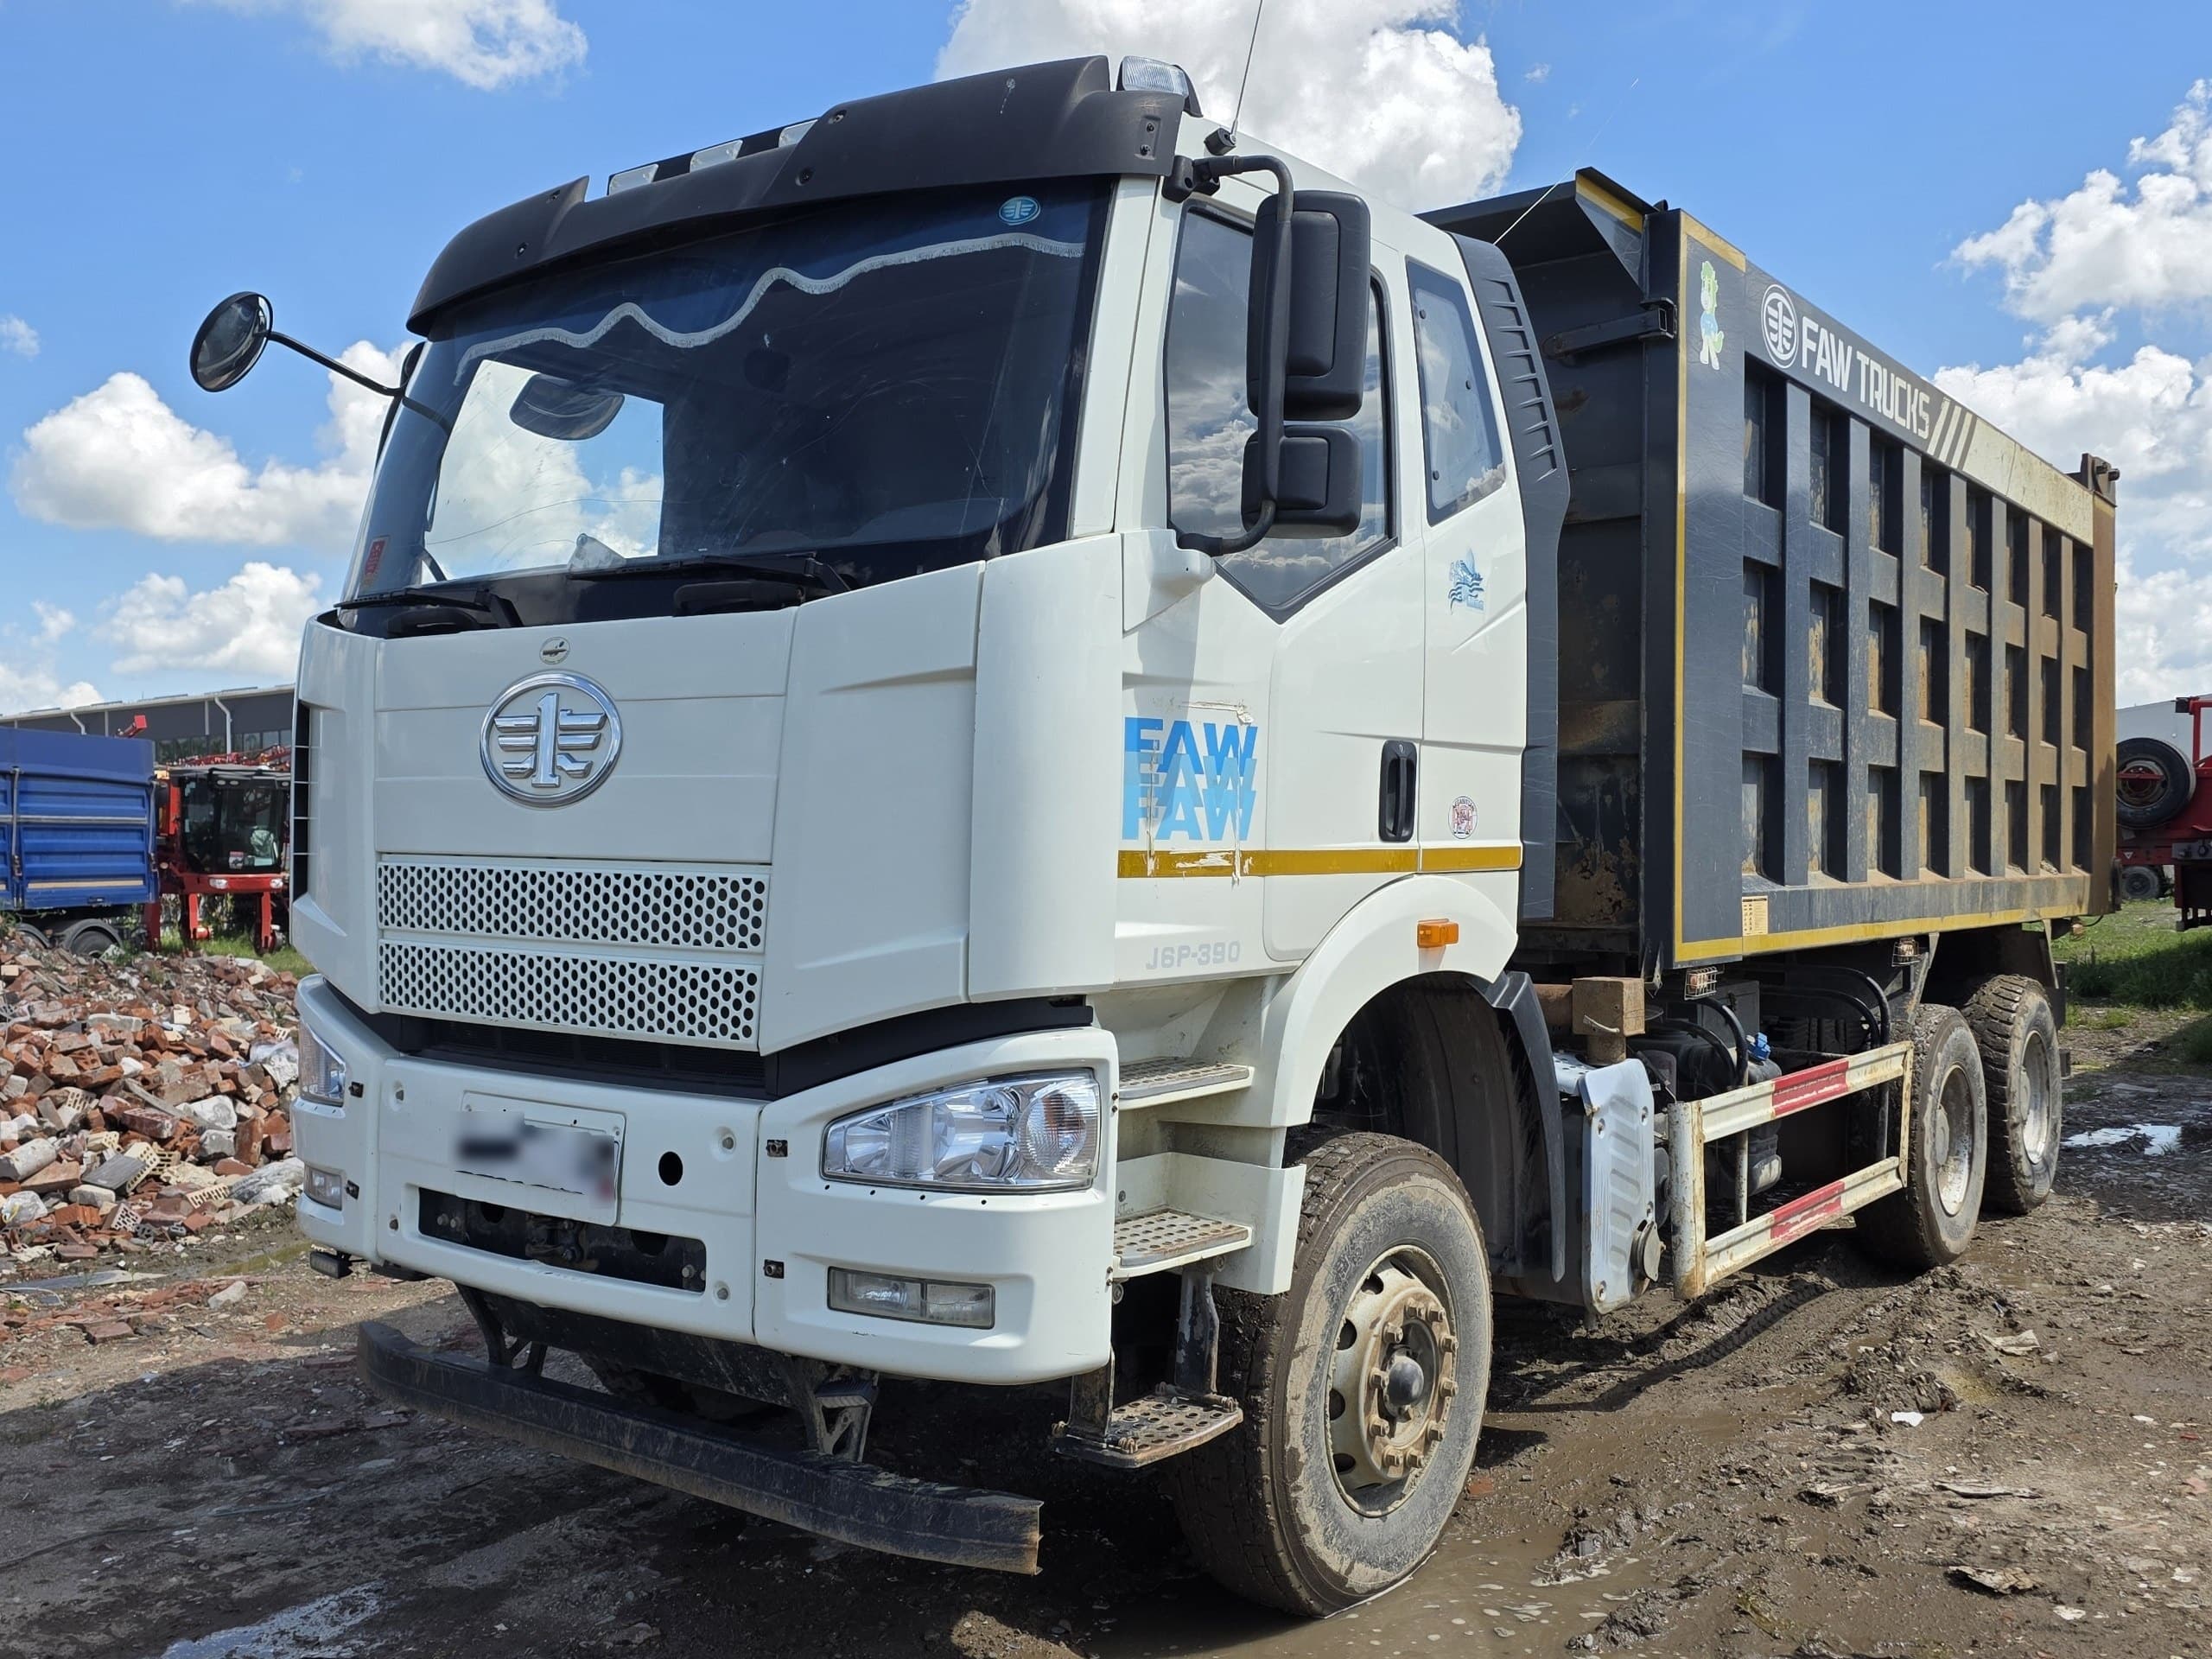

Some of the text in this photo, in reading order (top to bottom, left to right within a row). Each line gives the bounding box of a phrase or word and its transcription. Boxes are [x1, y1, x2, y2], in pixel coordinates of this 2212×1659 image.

[1802, 316, 1930, 440] FAW TRUCKS
[1124, 716, 1258, 778] FAW
[1122, 785, 1257, 842] FAW
[1146, 941, 1241, 969] J6P-390
